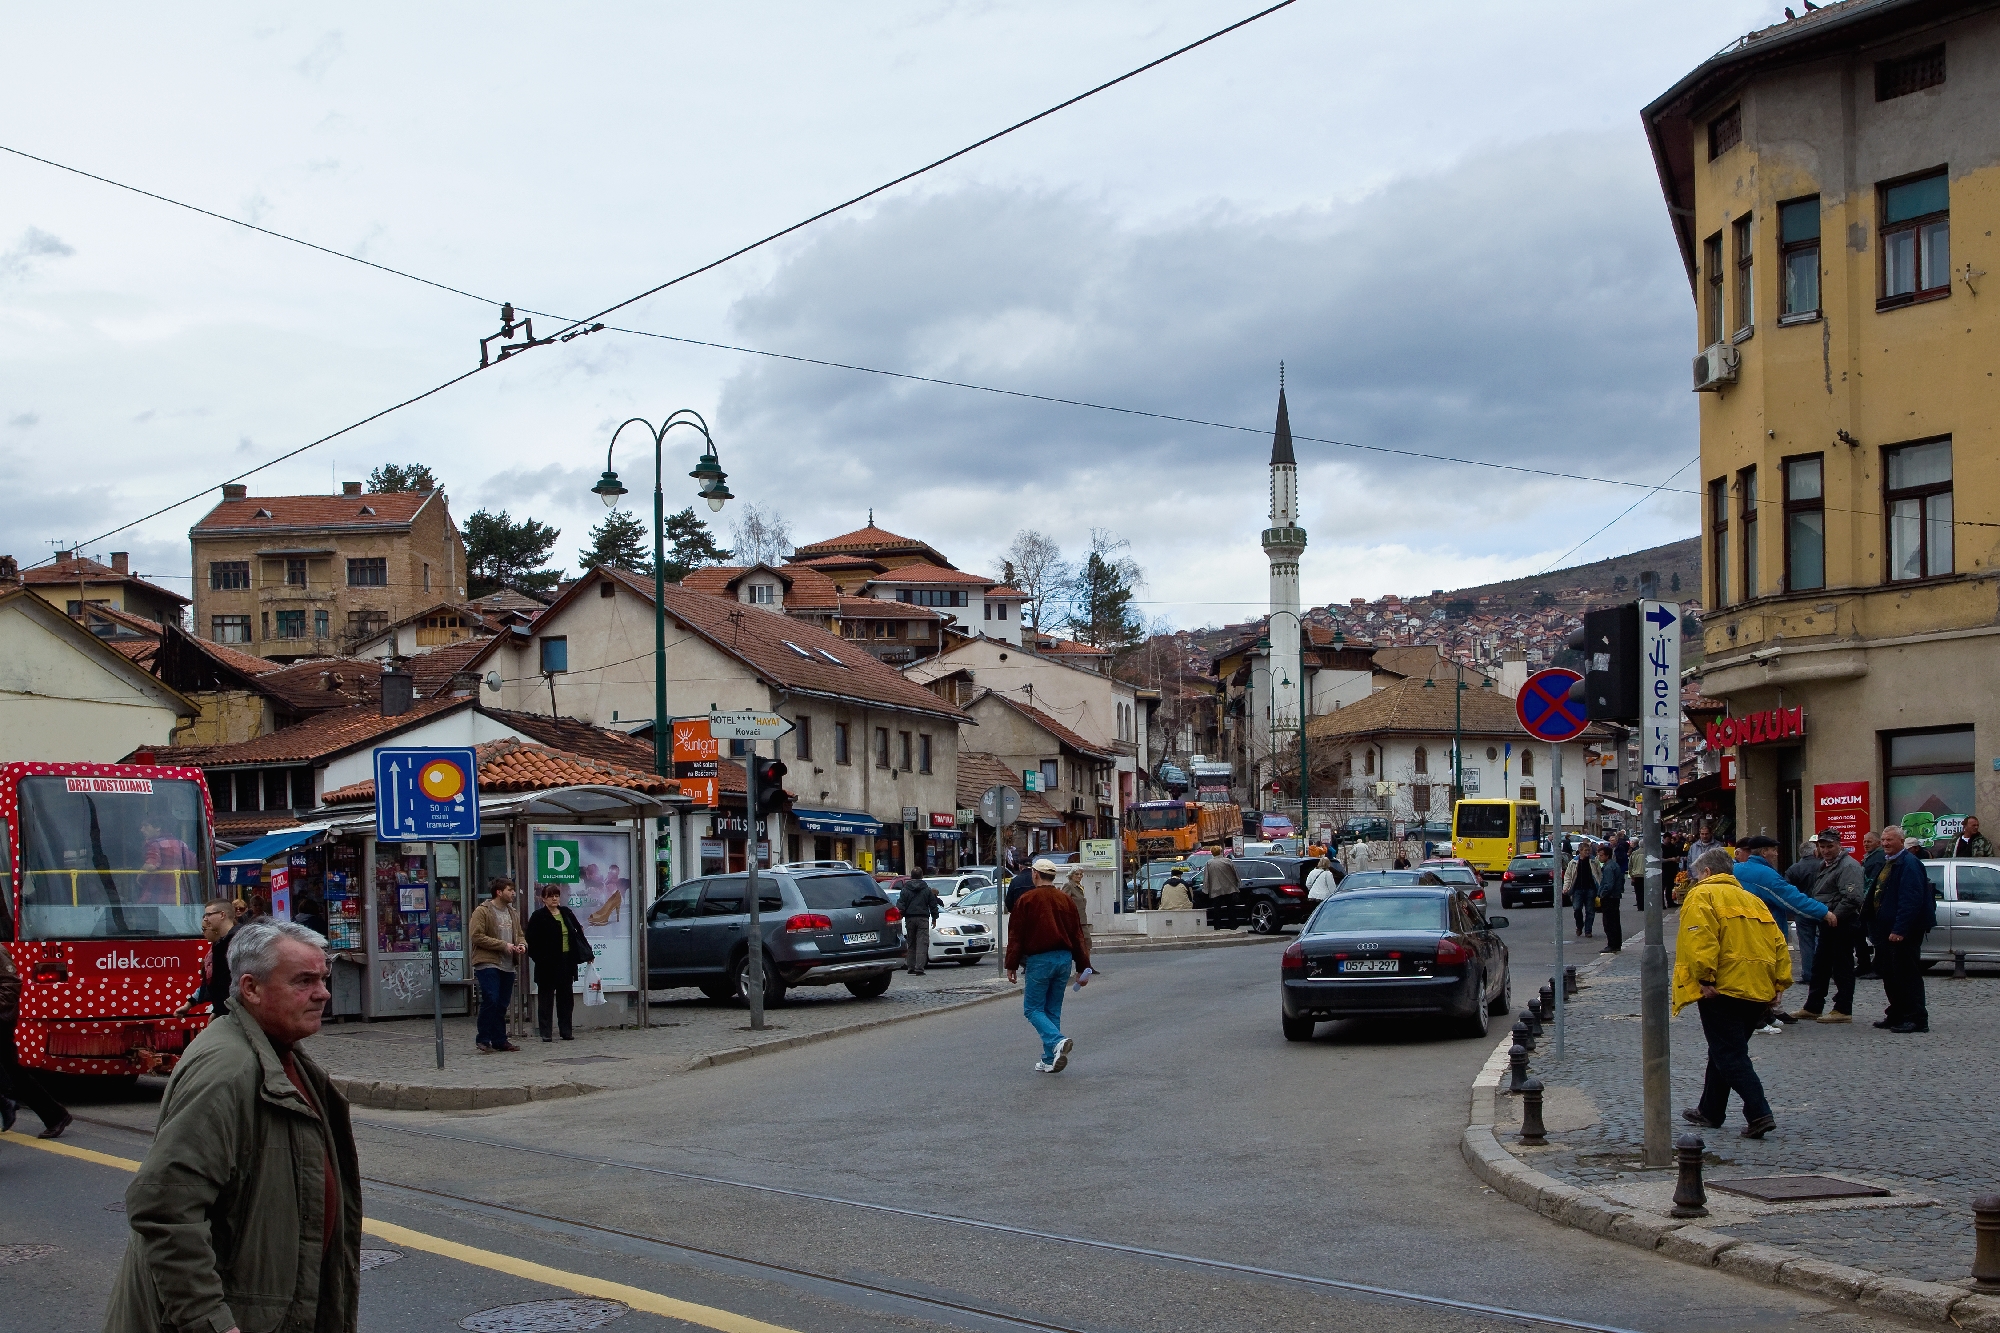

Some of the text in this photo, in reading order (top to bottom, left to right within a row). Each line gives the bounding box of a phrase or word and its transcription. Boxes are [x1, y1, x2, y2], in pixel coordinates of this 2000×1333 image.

[710, 716, 780, 726] HOTEL HAYAT
[735, 727, 760, 736] Kovači
[1706, 704, 1803, 752] KONZUM
[93, 780, 152, 792] ODSTOJANJE
[694, 790, 702, 798] m
[1820, 795, 1862, 806] KONZUM
[430, 804, 440, 812] 50
[717, 811, 765, 838] print sop
[547, 846, 571, 872] D
[96, 949, 180, 970] cilek.com
[1345, 961, 1397, 971] 057-J-297
